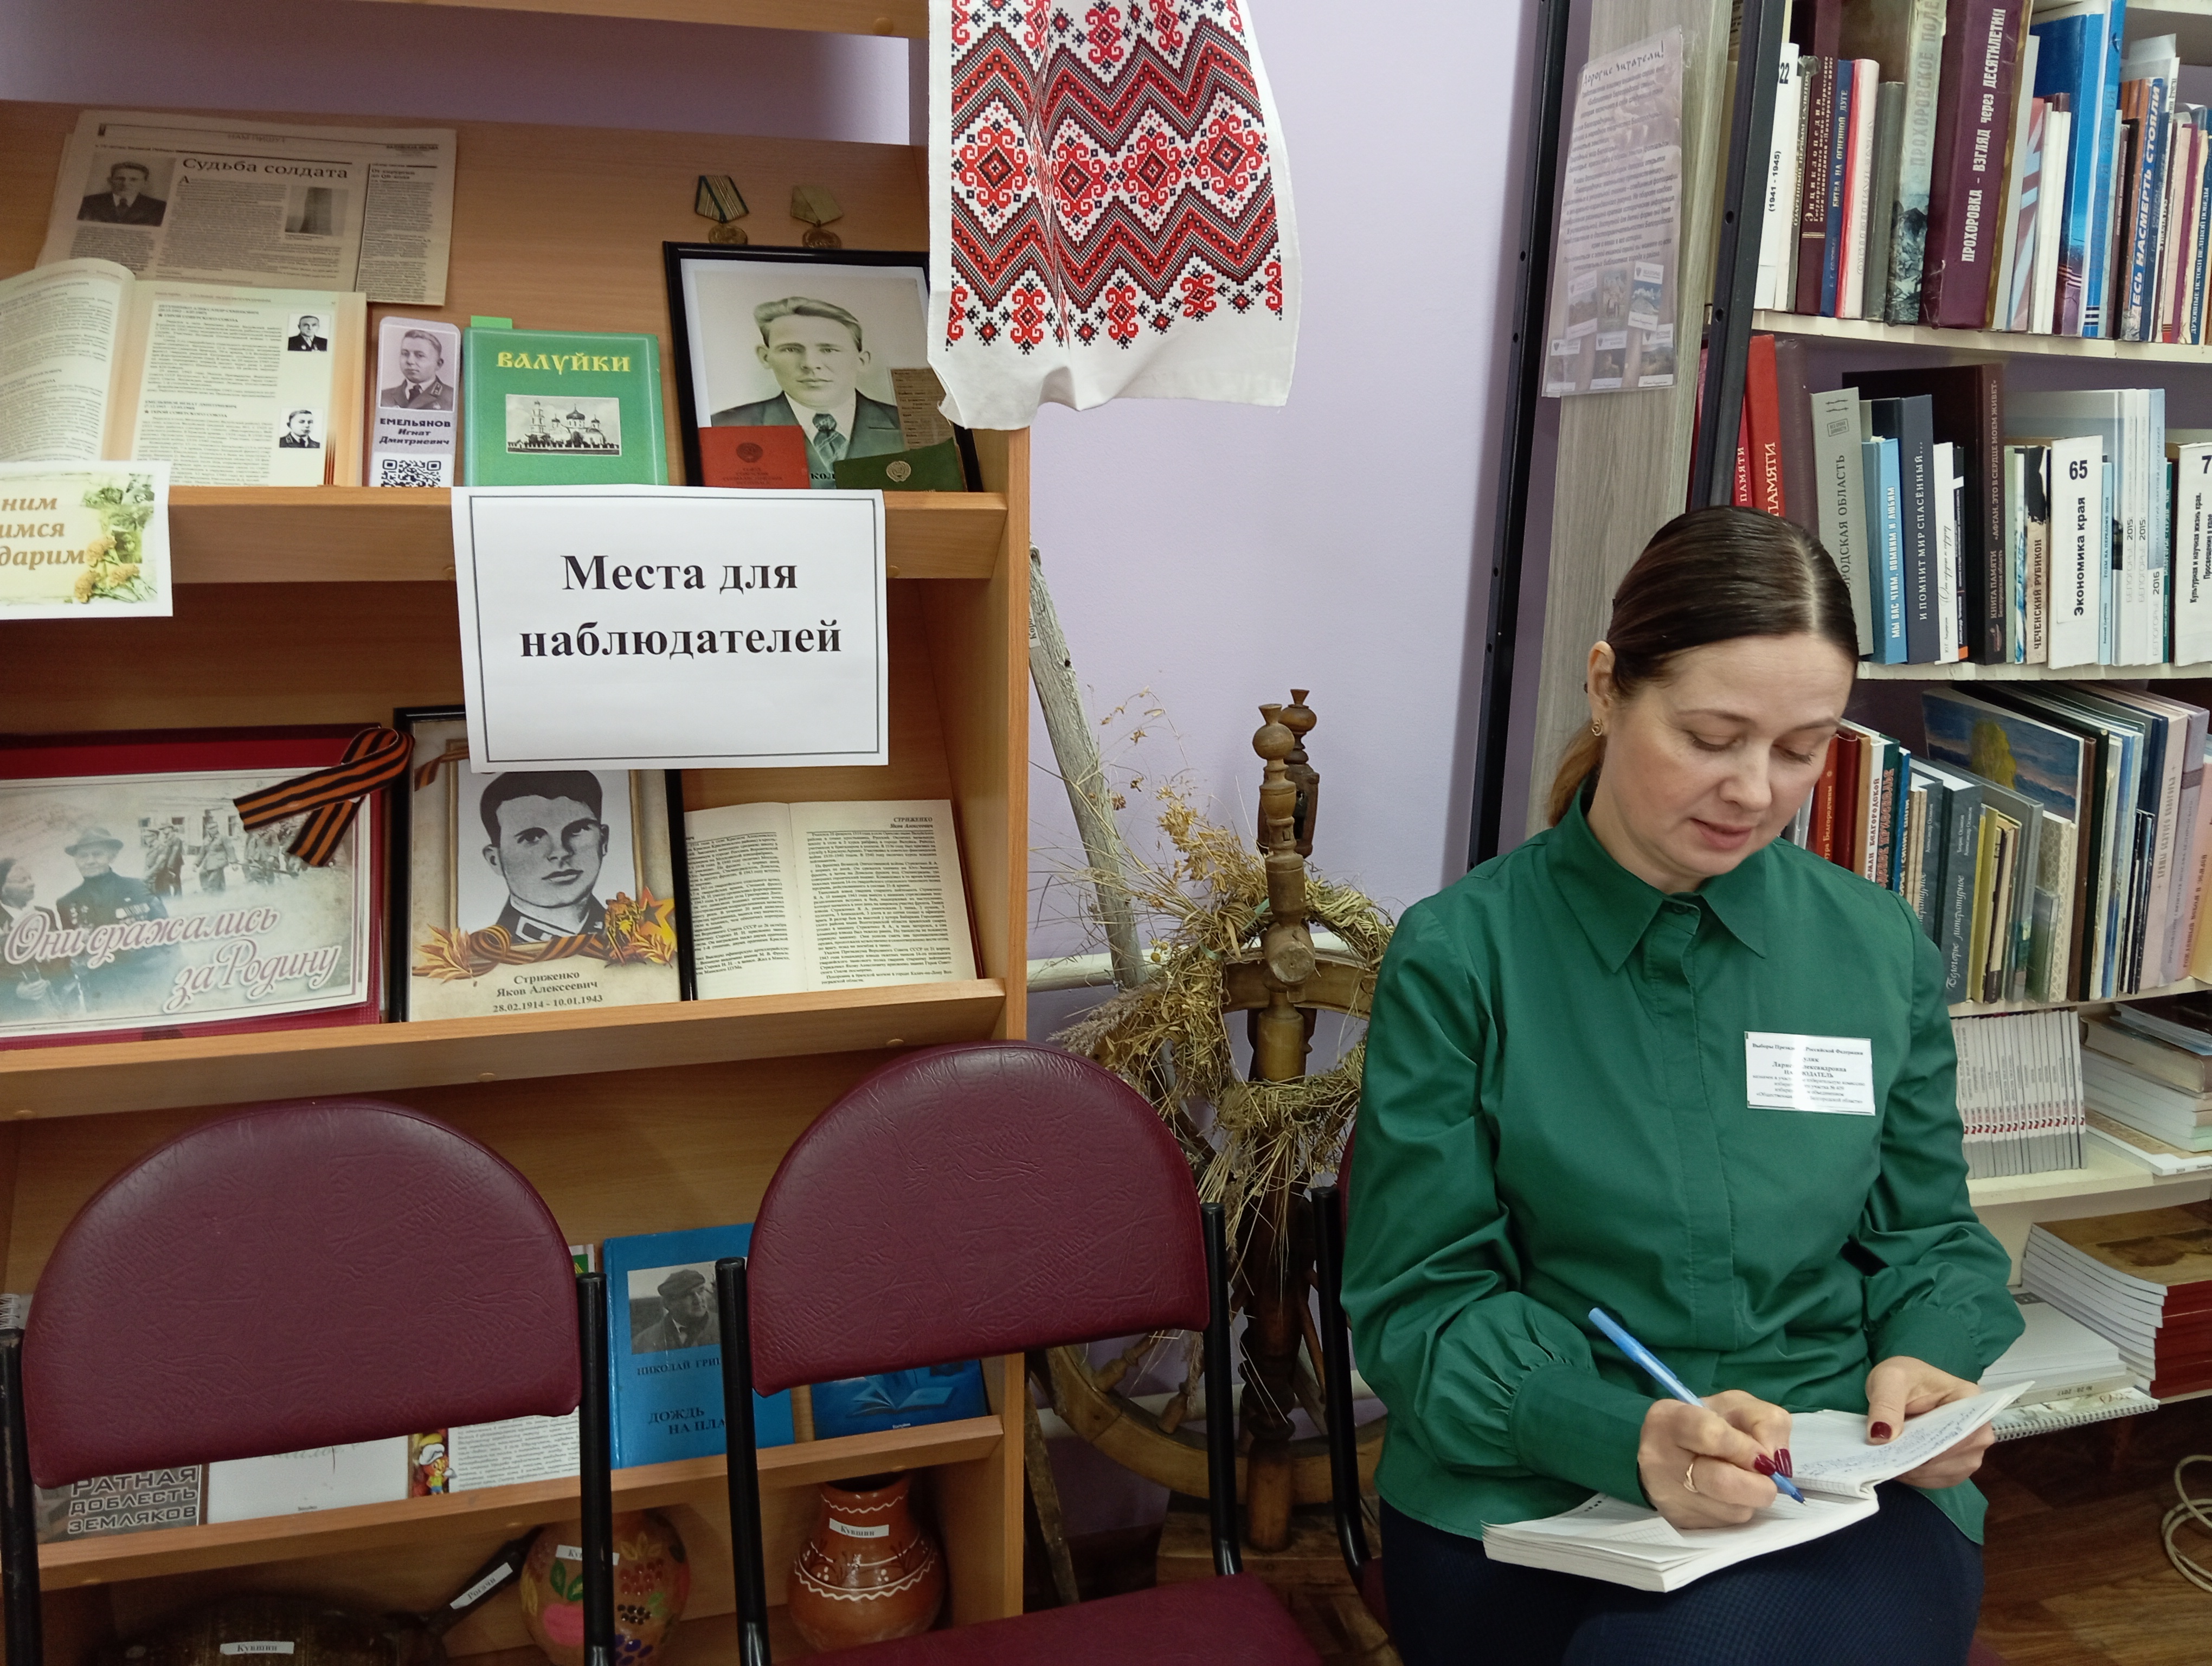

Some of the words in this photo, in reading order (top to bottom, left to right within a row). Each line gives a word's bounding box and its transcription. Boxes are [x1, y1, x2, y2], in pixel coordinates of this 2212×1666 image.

[1583, 67, 1613, 87] Дорогие
[1616, 40, 1664, 72] читатели!
[1983, 8, 2007, 88] ДЕСЯТИЛЕТИЯ
[1779, 62, 1790, 85] 22
[1908, 52, 1934, 167] ПРОХОРОВСКОЕ
[1921, 1, 1940, 42] ПОЛЕ
[1800, 71, 1811, 120] САЛЮТОМ
[1838, 89, 1848, 112] ДУГЕ
[1980, 93, 1995, 124] через
[1836, 117, 1846, 159] ОГНЕННОЙ
[2144, 85, 2161, 164] СТОЯЛИ
[1796, 124, 1806, 164] ПЕРВЫМ
[1972, 130, 1992, 172] ВЗГЛЯД
[183, 158, 256, 175] Судьба
[264, 163, 348, 178] солдата
[1772, 151, 1781, 177] 1945)
[1834, 164, 1842, 176] НА
[1768, 186, 1777, 212] (1941
[1832, 181, 1841, 207] БИТВА
[2201, 187, 2209, 220] ПОБЕДЫ
[1961, 189, 1983, 262] ПРОХОРОВКА
[2135, 169, 2152, 267] НАСМЕРТЬ
[2197, 221, 2206, 259] ВЕЛИКОЙ
[2194, 259, 2203, 290] ИСТОКИ
[2130, 271, 2144, 329] ЗДЕСЬ
[2190, 291, 2200, 334] ДУХОВНЫЕ
[496, 351, 631, 375] ВАЛУЙКИ
[380, 418, 451, 427] ЕМЕЛЬЯНОВ
[379, 435, 449, 446] Дмитриевич
[1737, 446, 1748, 502] ПАМЯТИ
[1764, 442, 1779, 516] ПАМЯТИ
[1836, 454, 1848, 516] ОБЛАСТЬ
[2069, 459, 2088, 480] 65
[2, 498, 58, 511] ним
[1887, 486, 1896, 520] ЛЮБИМ
[2076, 497, 2086, 530] края
[1888, 533, 1898, 571] ПОМНИМ
[1917, 533, 1926, 557] МИР
[561, 554, 706, 590] Места
[719, 564, 798, 595] для
[1989, 550, 1997, 588] ПАМЯТИ
[2034, 539, 2042, 586] РУБИКОН
[2074, 535, 2086, 616] Экономика
[1889, 574, 1899, 600] ЧТИМ,
[1918, 560, 1927, 610] ПОМНИТ
[2151, 572, 2159, 595] 2016
[2189, 567, 2198, 603] Культурная
[1890, 603, 1900, 619] ВАС
[2034, 589, 2042, 650] ЧЕЧЕНСКИЙ
[519, 619, 842, 660] наблюдателей
[1891, 622, 1901, 638] МЫ
[1823, 786, 1832, 842] Белгородчины
[1869, 778, 1880, 846] БЕЛГОРОДСКОЙ
[1878, 768, 1895, 844] ПРИОСКОЛЬЕ
[1952, 875, 1965, 940] литературное
[5, 911, 84, 964] Они
[87, 906, 281, 969] сражались
[164, 962, 215, 1014] за
[216, 937, 342, 1001] Родину
[514, 972, 580, 985] Стриженко
[1946, 943, 1960, 990] Белогорье
[493, 1001, 544, 1013] 28.02.1914
[553, 994, 603, 1007] 10.01.1943
[497, 988, 526, 997] Яков
[530, 981, 598, 994] Алексеевич
[637, 1360, 690, 1375] НИКОЛАЙ
[648, 1407, 705, 1425] ДОЖДЬ
[668, 1423, 690, 1434] НА
[71, 1465, 198, 1497] РАТНАЯ
[68, 1504, 198, 1534] ЗЕМЛЯКОВ
[69, 1487, 198, 1517] ДОБЛЕСТЬ
[840, 1525, 875, 1536] Кувшин
[236, 1643, 278, 1652] Кувшин
